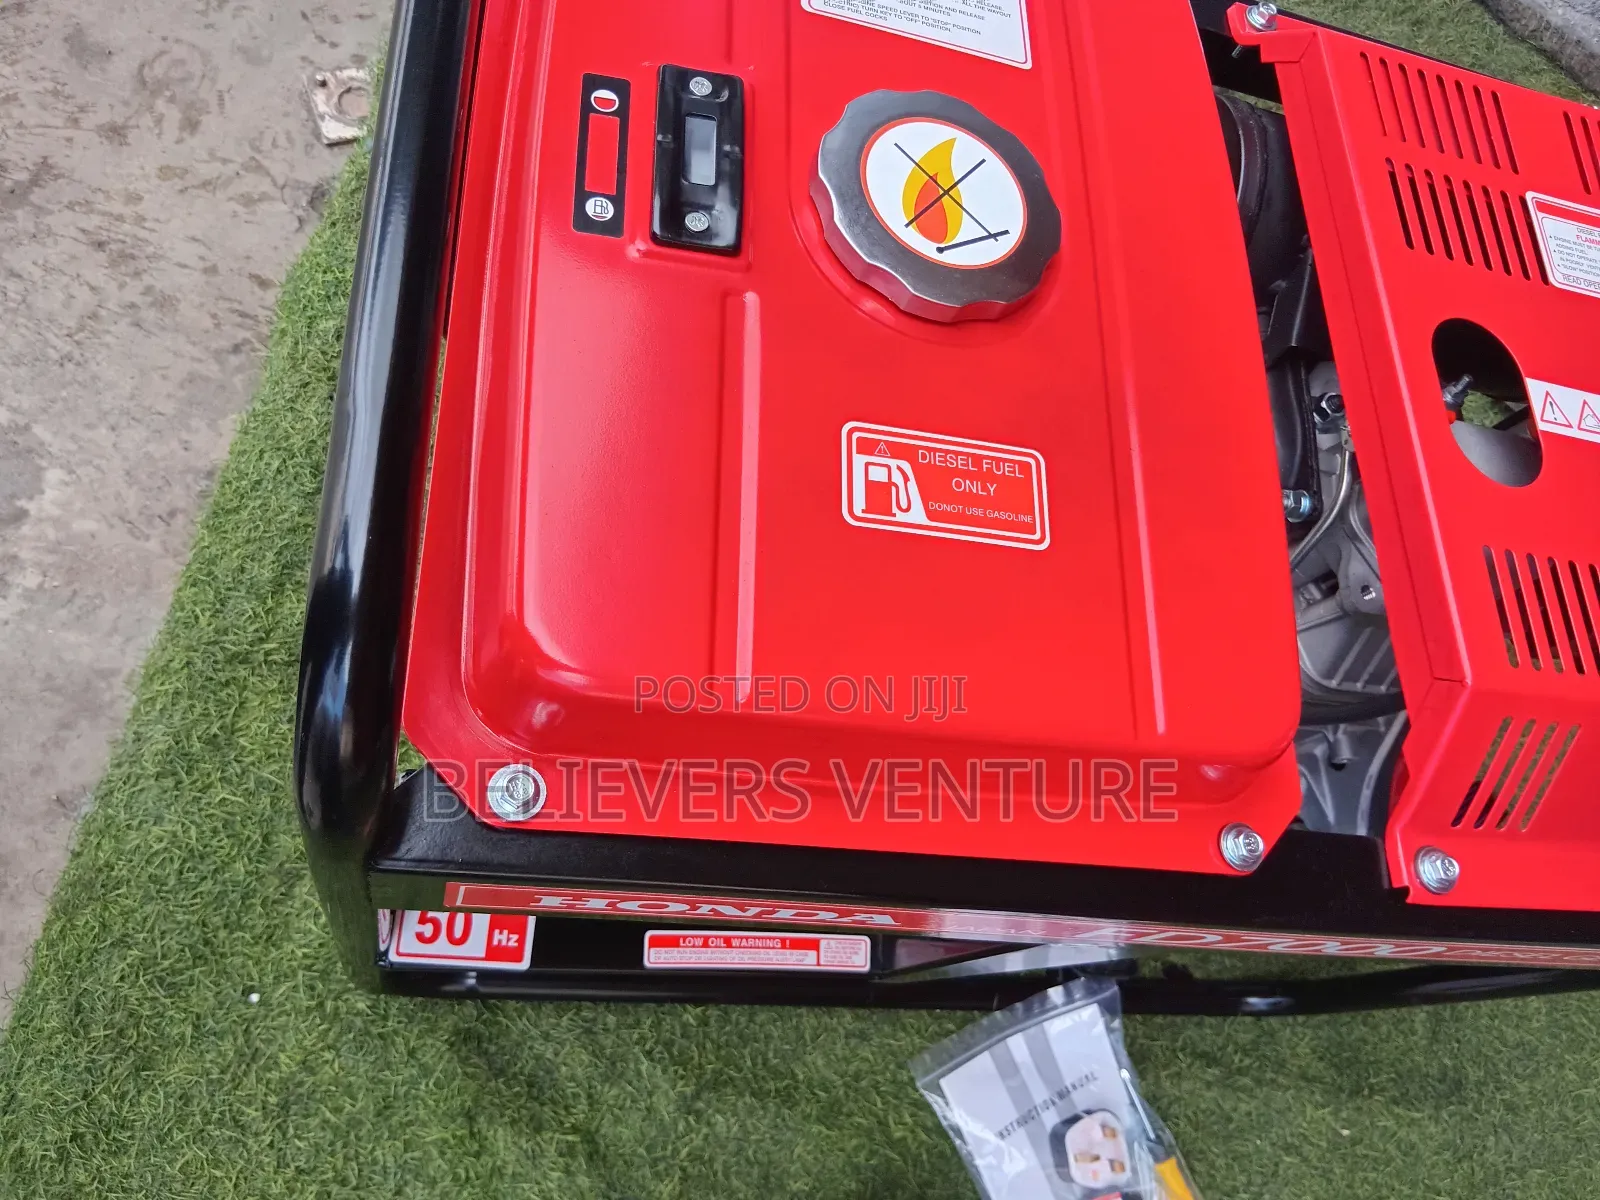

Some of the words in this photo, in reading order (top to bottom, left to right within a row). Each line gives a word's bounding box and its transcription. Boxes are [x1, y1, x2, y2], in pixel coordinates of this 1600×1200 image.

[918, 449, 978, 471] DIESEL
[982, 459, 1025, 478] FUEL
[951, 477, 998, 497] ONLY
[928, 501, 963, 514] DONOT
[965, 507, 985, 517] USE
[986, 509, 1034, 524] GASOLINE
[529, 895, 901, 926] HONDA
[414, 910, 474, 946] 50
[492, 929, 519, 947] Hz
[680, 937, 704, 946] LOW
[708, 937, 727, 947] OIL
[731, 938, 782, 948] WARNING
